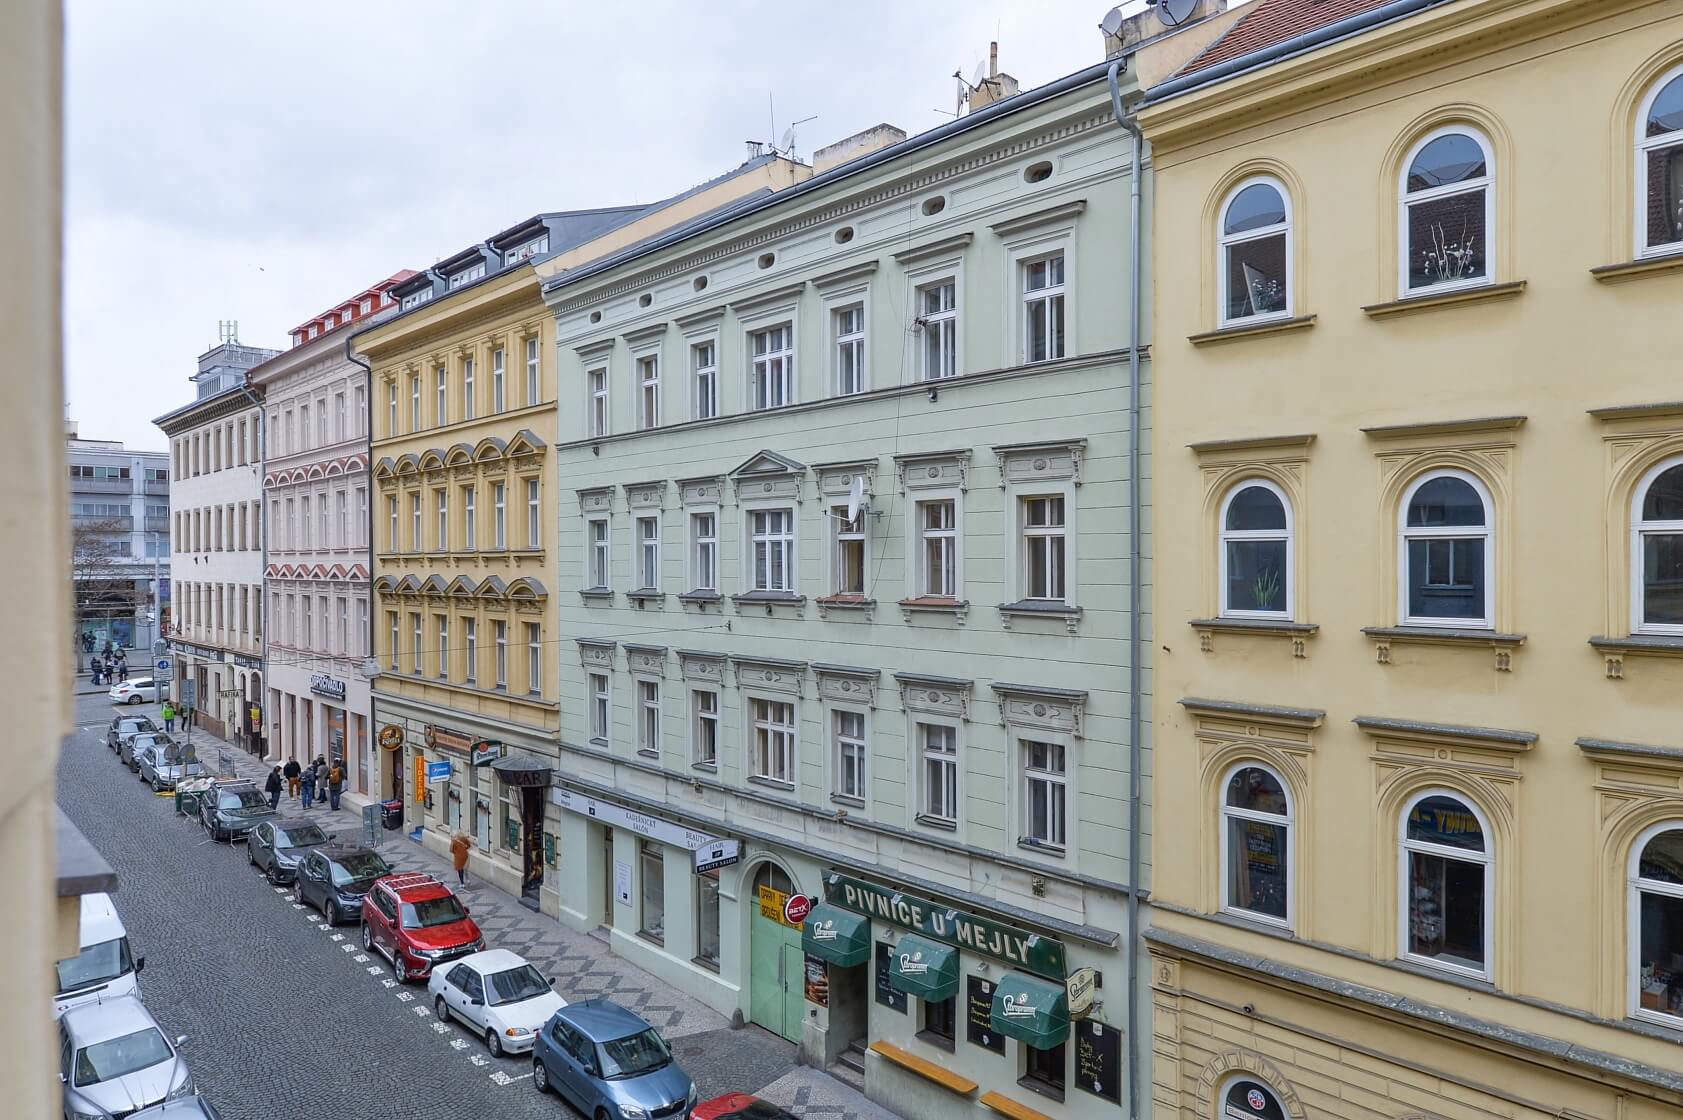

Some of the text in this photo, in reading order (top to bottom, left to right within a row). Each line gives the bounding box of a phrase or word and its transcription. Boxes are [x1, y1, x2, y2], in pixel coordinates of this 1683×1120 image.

[844, 884, 1029, 964] PIVNICE U MEJLY
